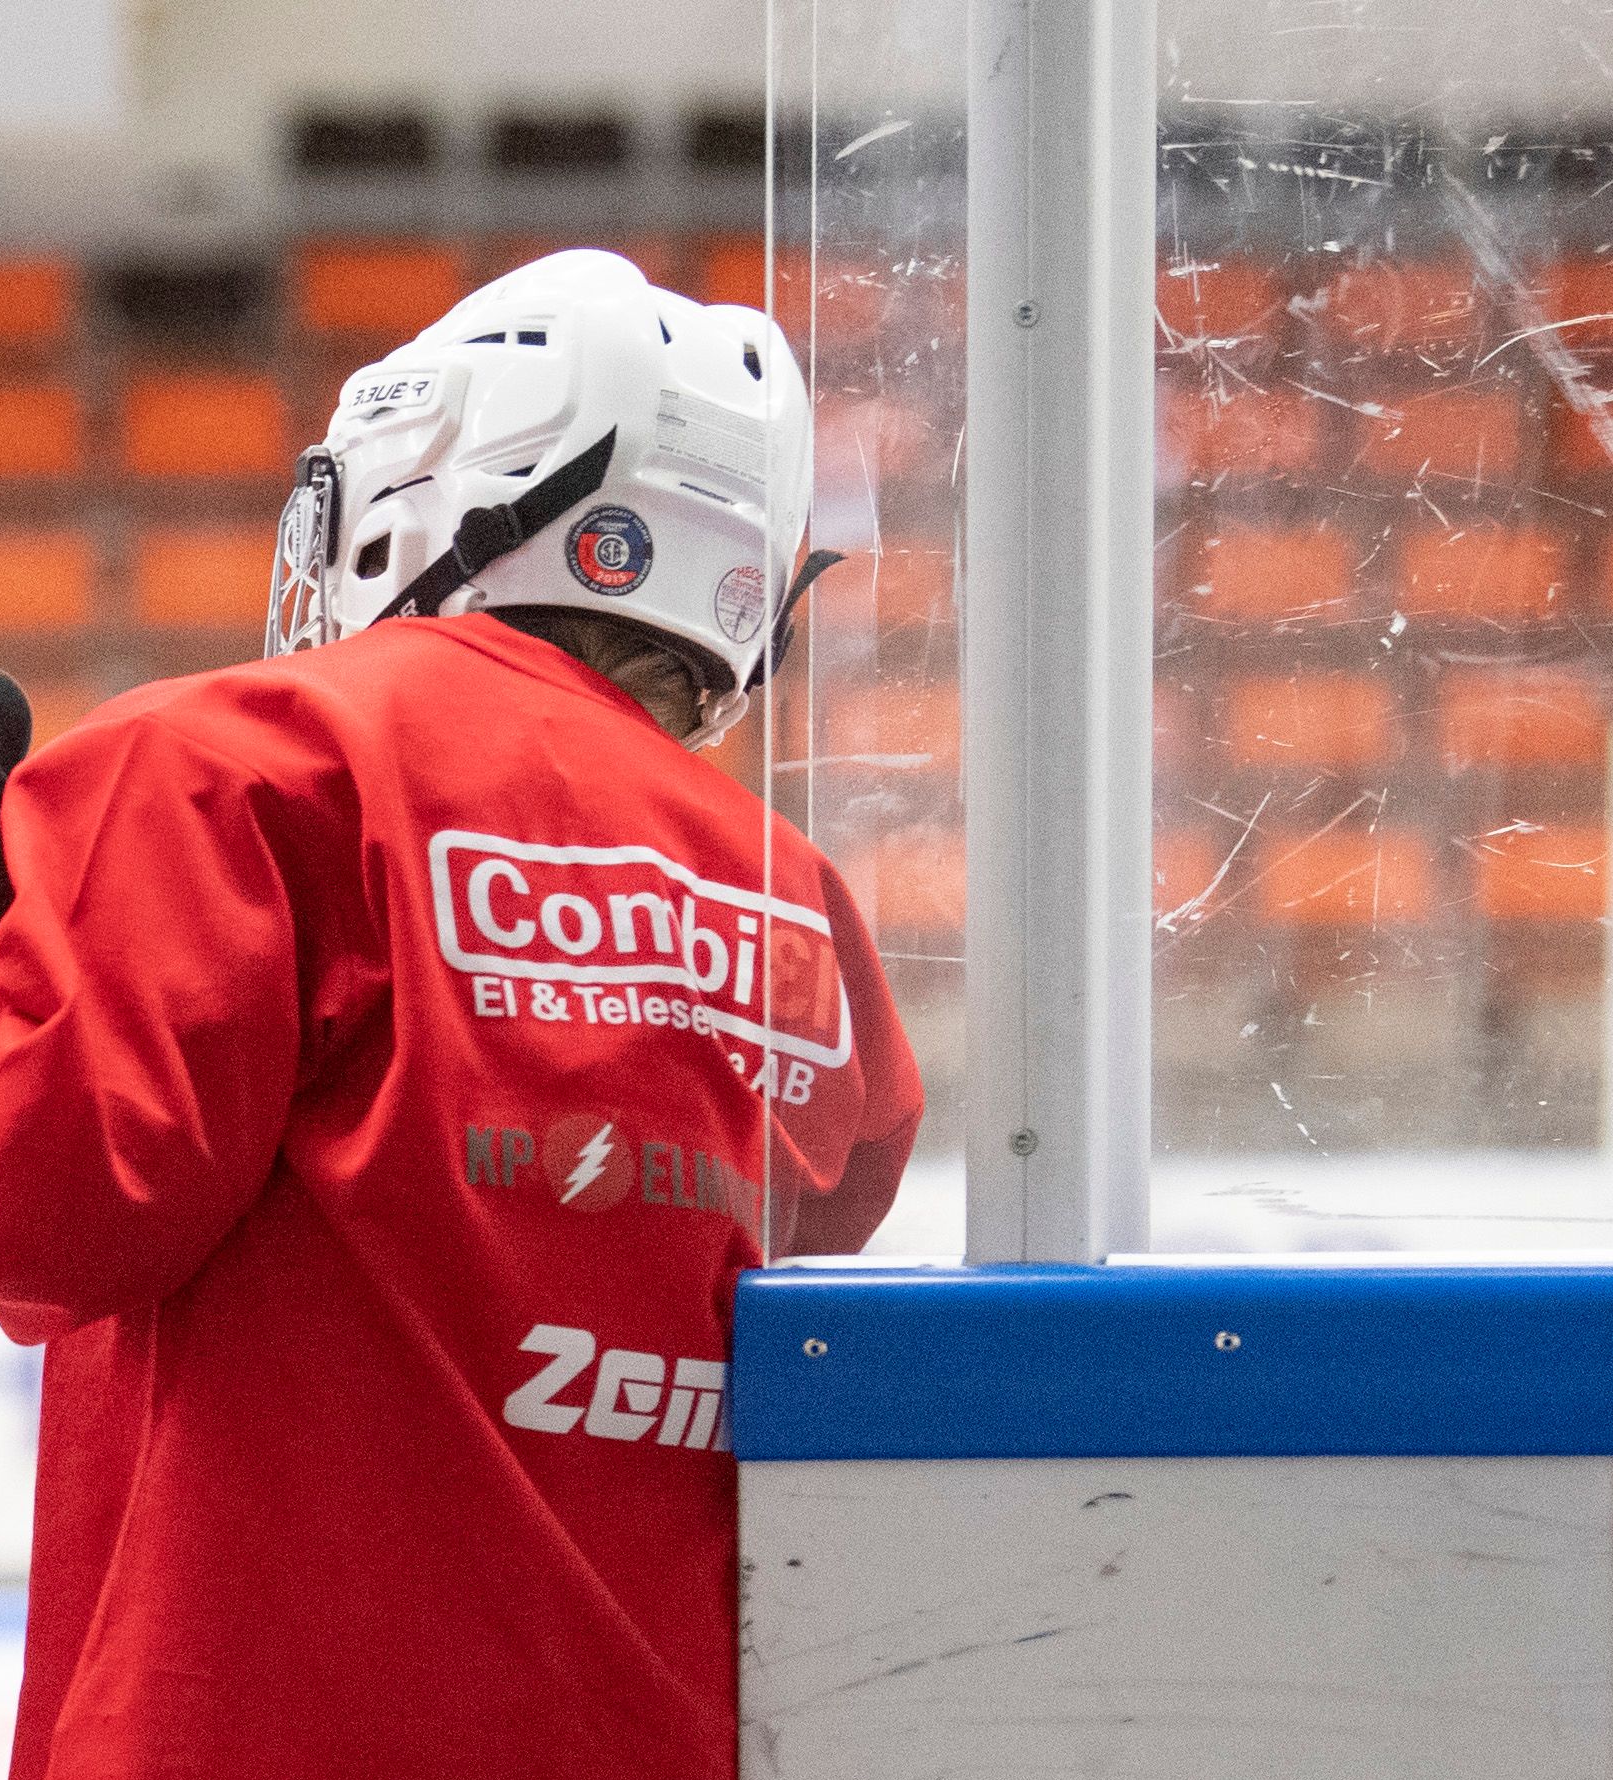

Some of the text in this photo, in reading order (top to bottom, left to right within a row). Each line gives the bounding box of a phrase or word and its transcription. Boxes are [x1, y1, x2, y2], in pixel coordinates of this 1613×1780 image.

[529, 981, 571, 1022] &
[751, 1053, 815, 1105] AB
[465, 1123, 534, 1188] KP
